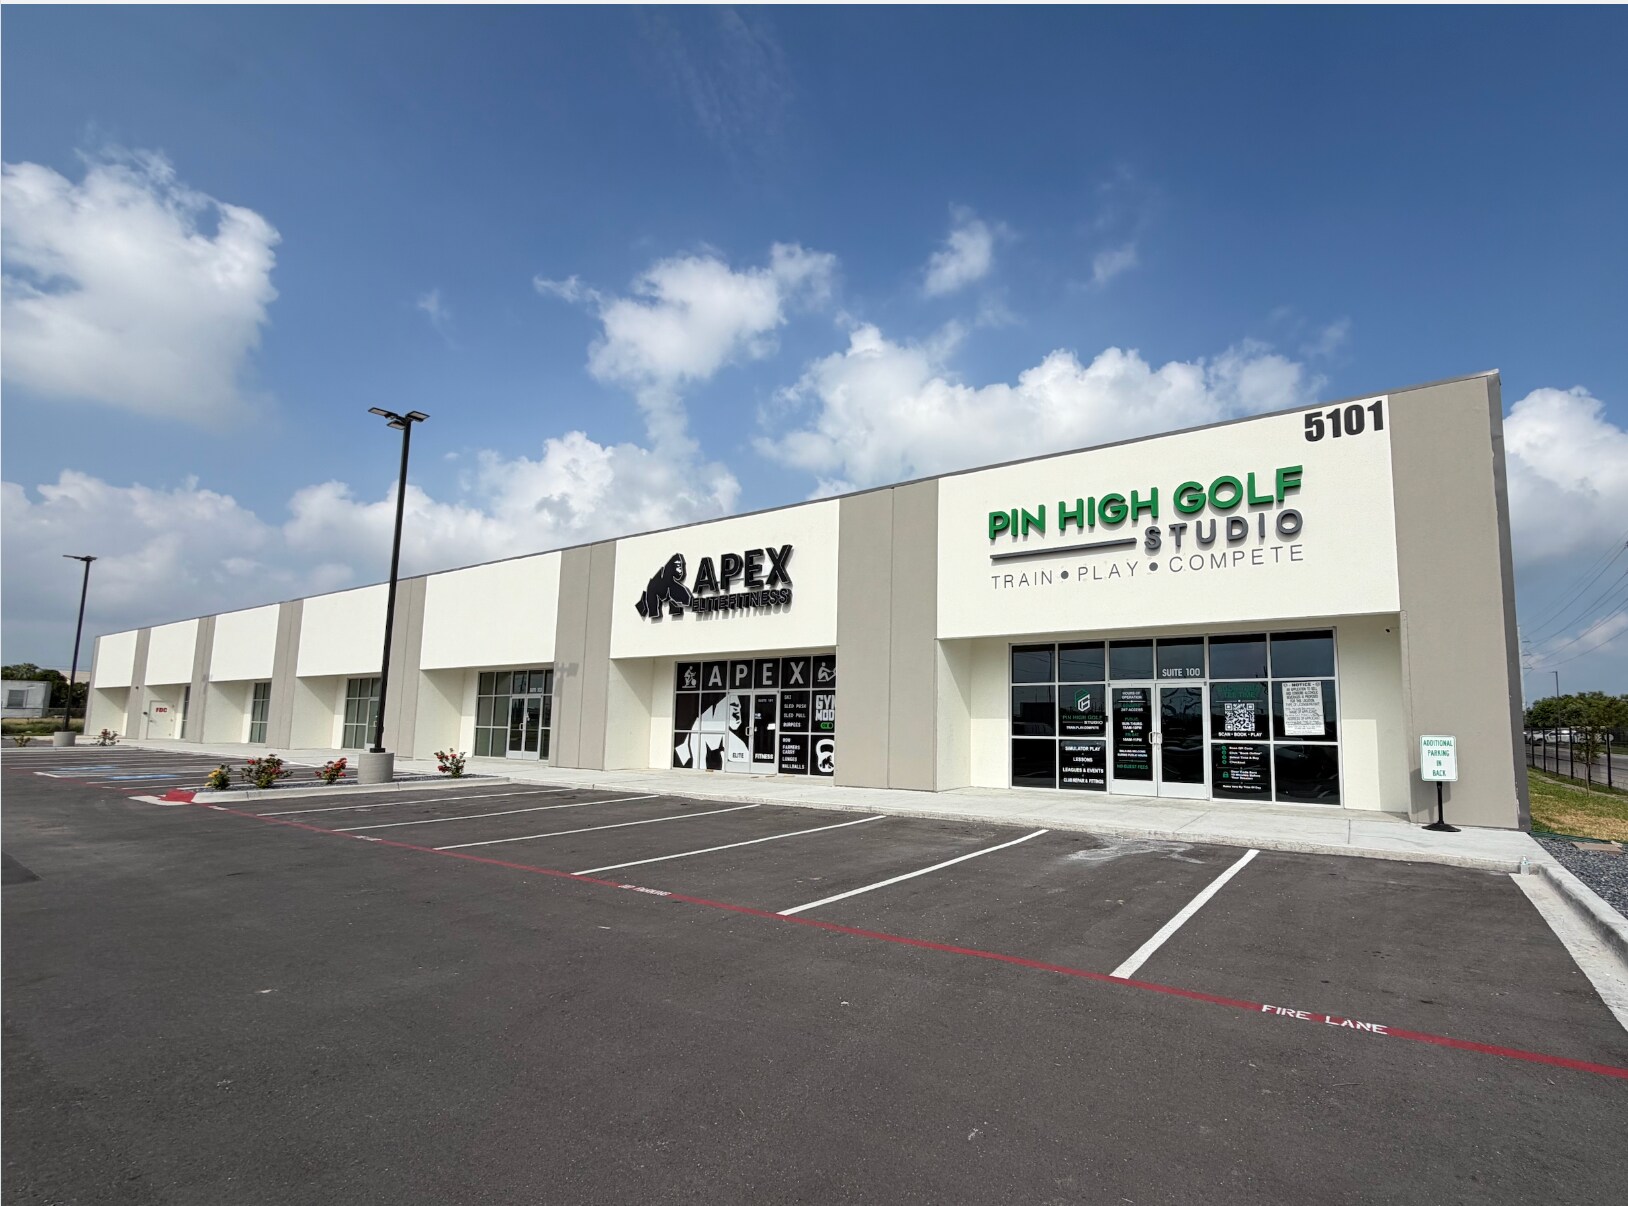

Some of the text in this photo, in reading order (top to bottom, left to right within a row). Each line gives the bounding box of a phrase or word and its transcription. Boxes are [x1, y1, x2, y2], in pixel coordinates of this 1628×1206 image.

[1304, 400, 1384, 442] 5101
[988, 464, 1303, 540] PIN HIGH GOLF
[1144, 508, 1304, 550] STUDIO
[693, 543, 794, 595] APEX
[991, 544, 1304, 590] TRAIN PLAY COMPETE
[1162, 667, 1201, 677] SUITE 100
[1423, 739, 1453, 747] ADDITIONAL
[1427, 749, 1450, 757] PARKING
[1432, 769, 1447, 777] BACK
[1262, 1004, 1388, 1035] FIRE LANE
